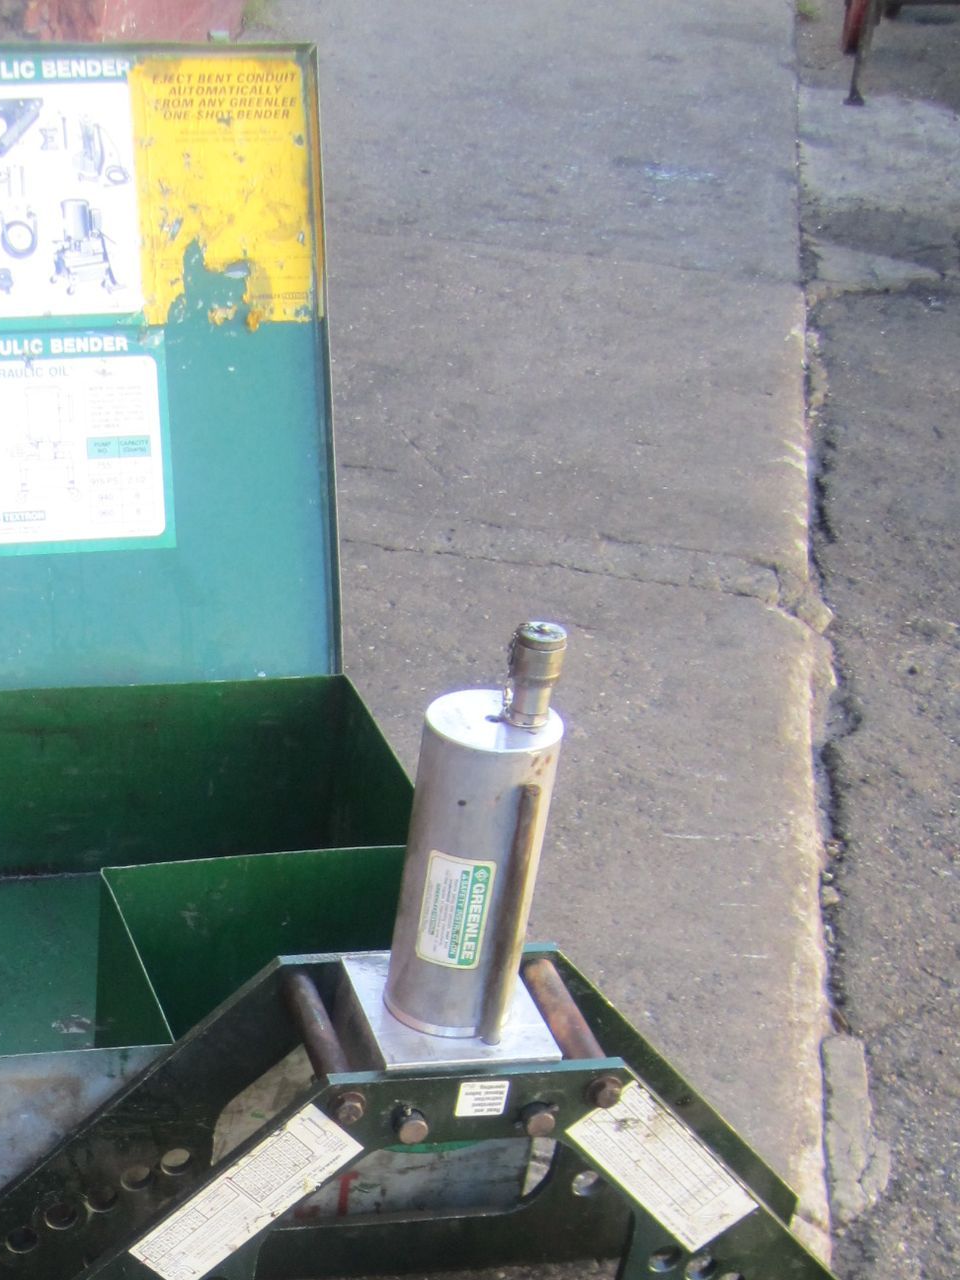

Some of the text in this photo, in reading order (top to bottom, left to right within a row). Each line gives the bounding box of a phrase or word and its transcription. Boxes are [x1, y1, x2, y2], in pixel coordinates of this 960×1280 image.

[197, 72, 233, 84] BENT
[236, 71, 297, 84] CONDUIT
[168, 84, 282, 97] AUTOMATICALLY
[154, 96, 297, 110] FROM ANY GREENLEE
[236, 108, 290, 120] BENDER
[50, 336, 129, 354] BENDER
[48, 366, 70, 377] OIL
[458, 882, 486, 961] GREENLEE
